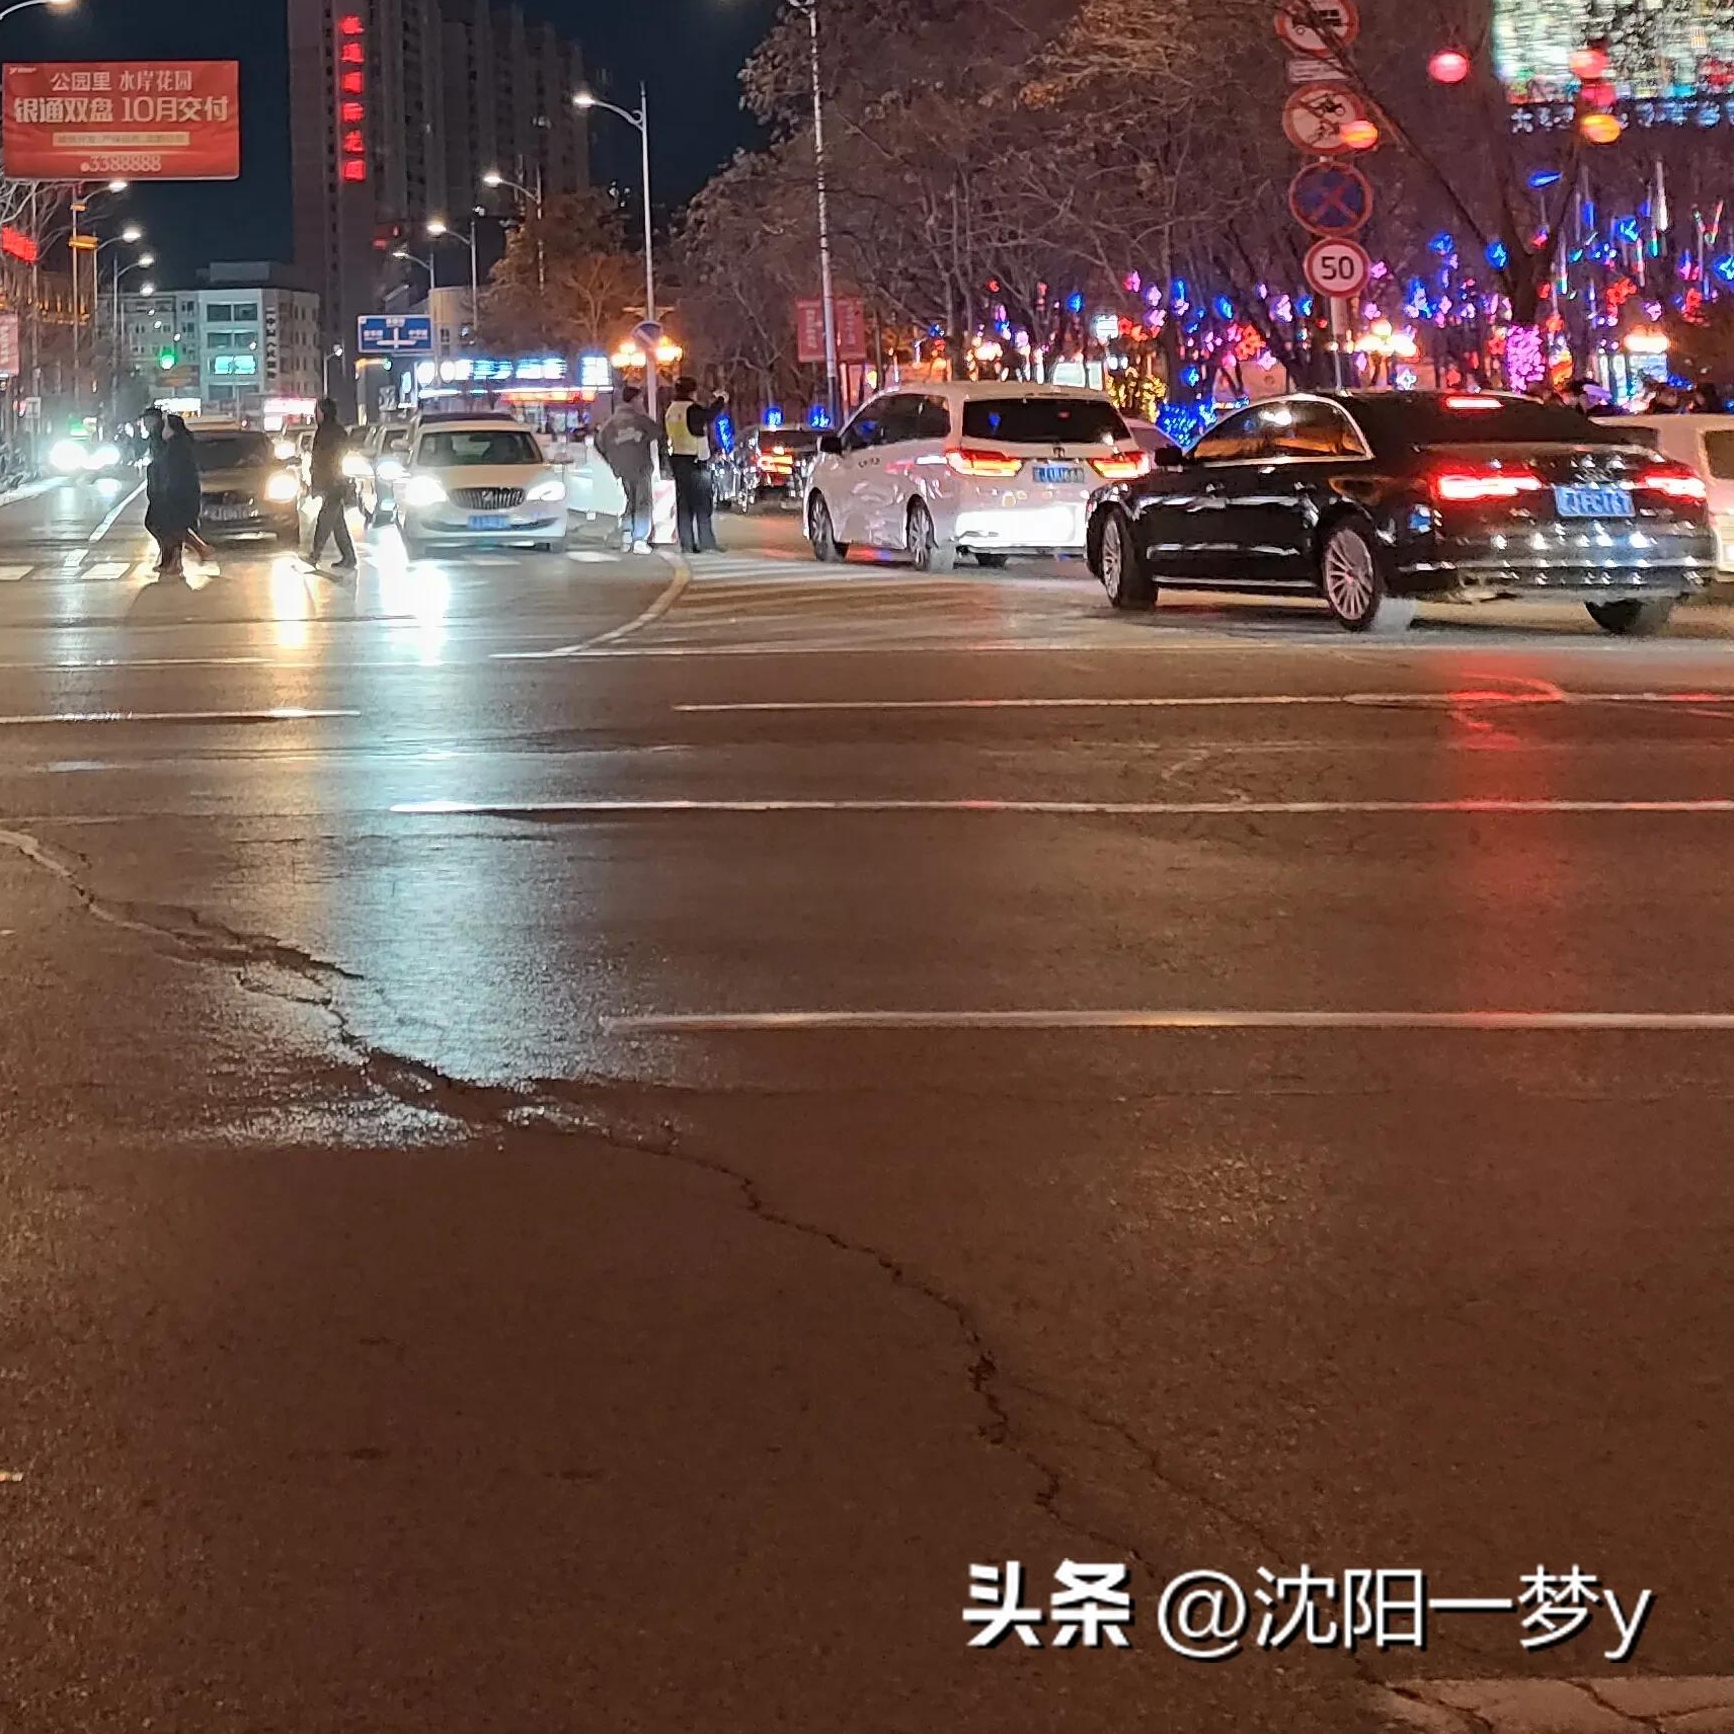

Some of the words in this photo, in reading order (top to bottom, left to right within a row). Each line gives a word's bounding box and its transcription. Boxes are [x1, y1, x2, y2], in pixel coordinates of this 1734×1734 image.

[50, 70, 112, 92] 公园里
[118, 70, 192, 92] 水岸花园
[14, 96, 114, 123] 银通双盘
[121, 96, 229, 123] 10月交付
[1322, 255, 1355, 280] 50
